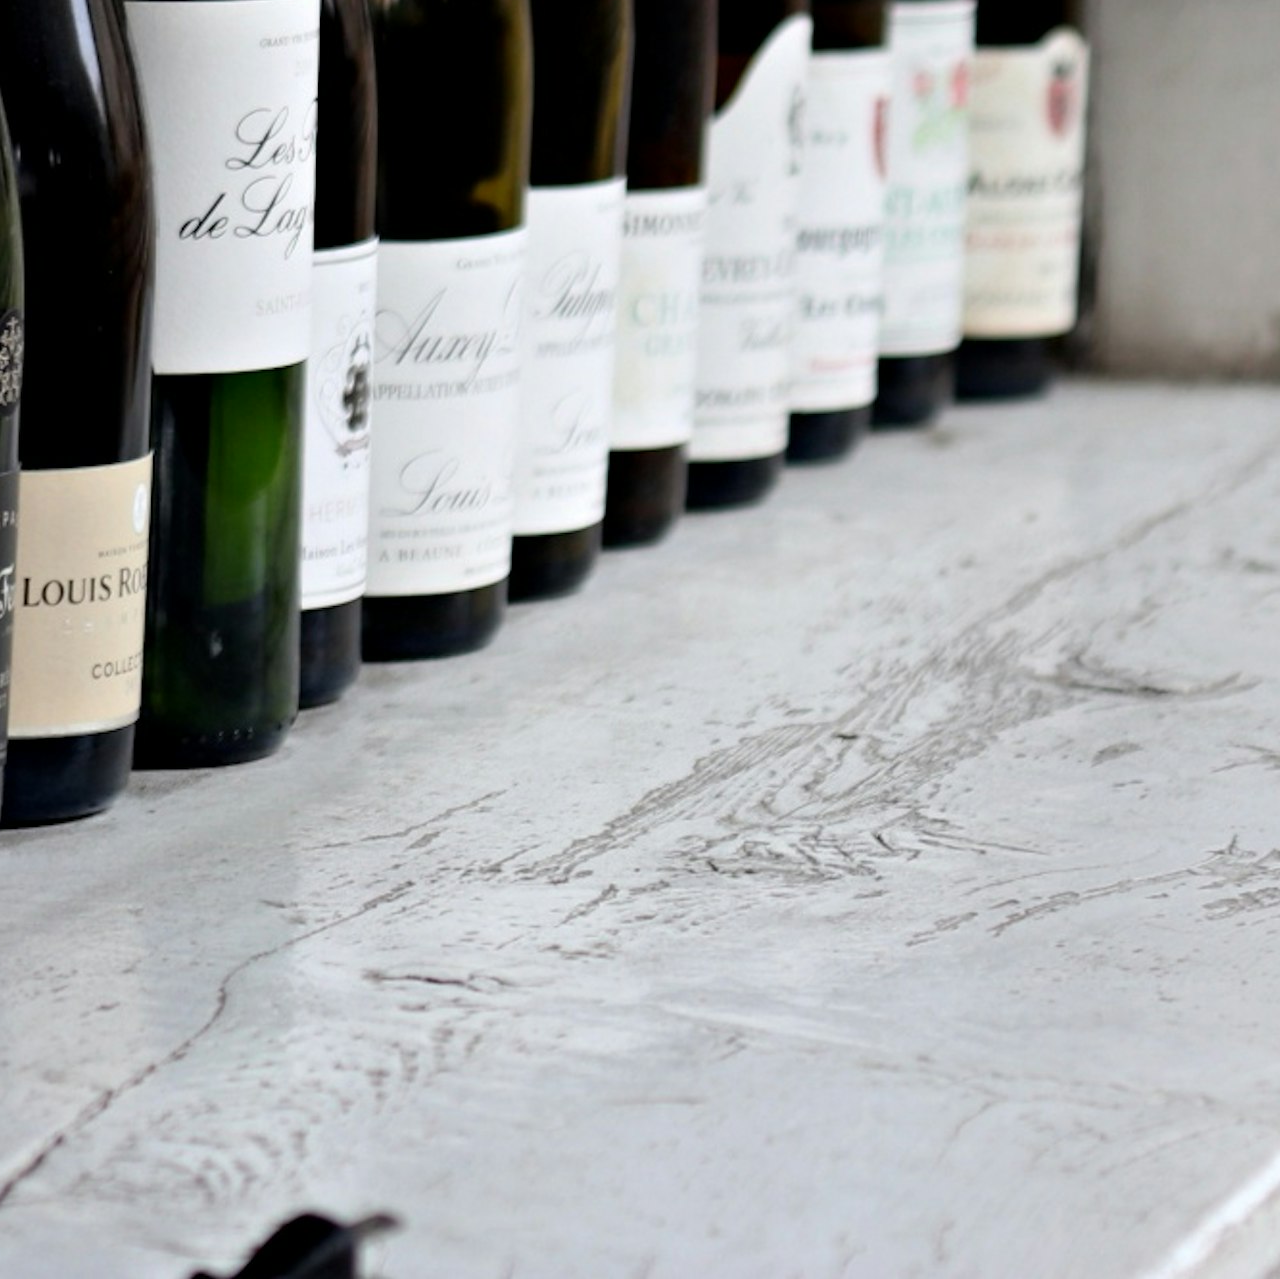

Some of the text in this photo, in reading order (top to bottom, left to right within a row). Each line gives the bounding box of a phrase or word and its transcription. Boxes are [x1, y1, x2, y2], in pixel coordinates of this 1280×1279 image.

[225, 106, 296, 170] Les
[179, 192, 228, 240] de
[22, 573, 113, 609] LOUIS
